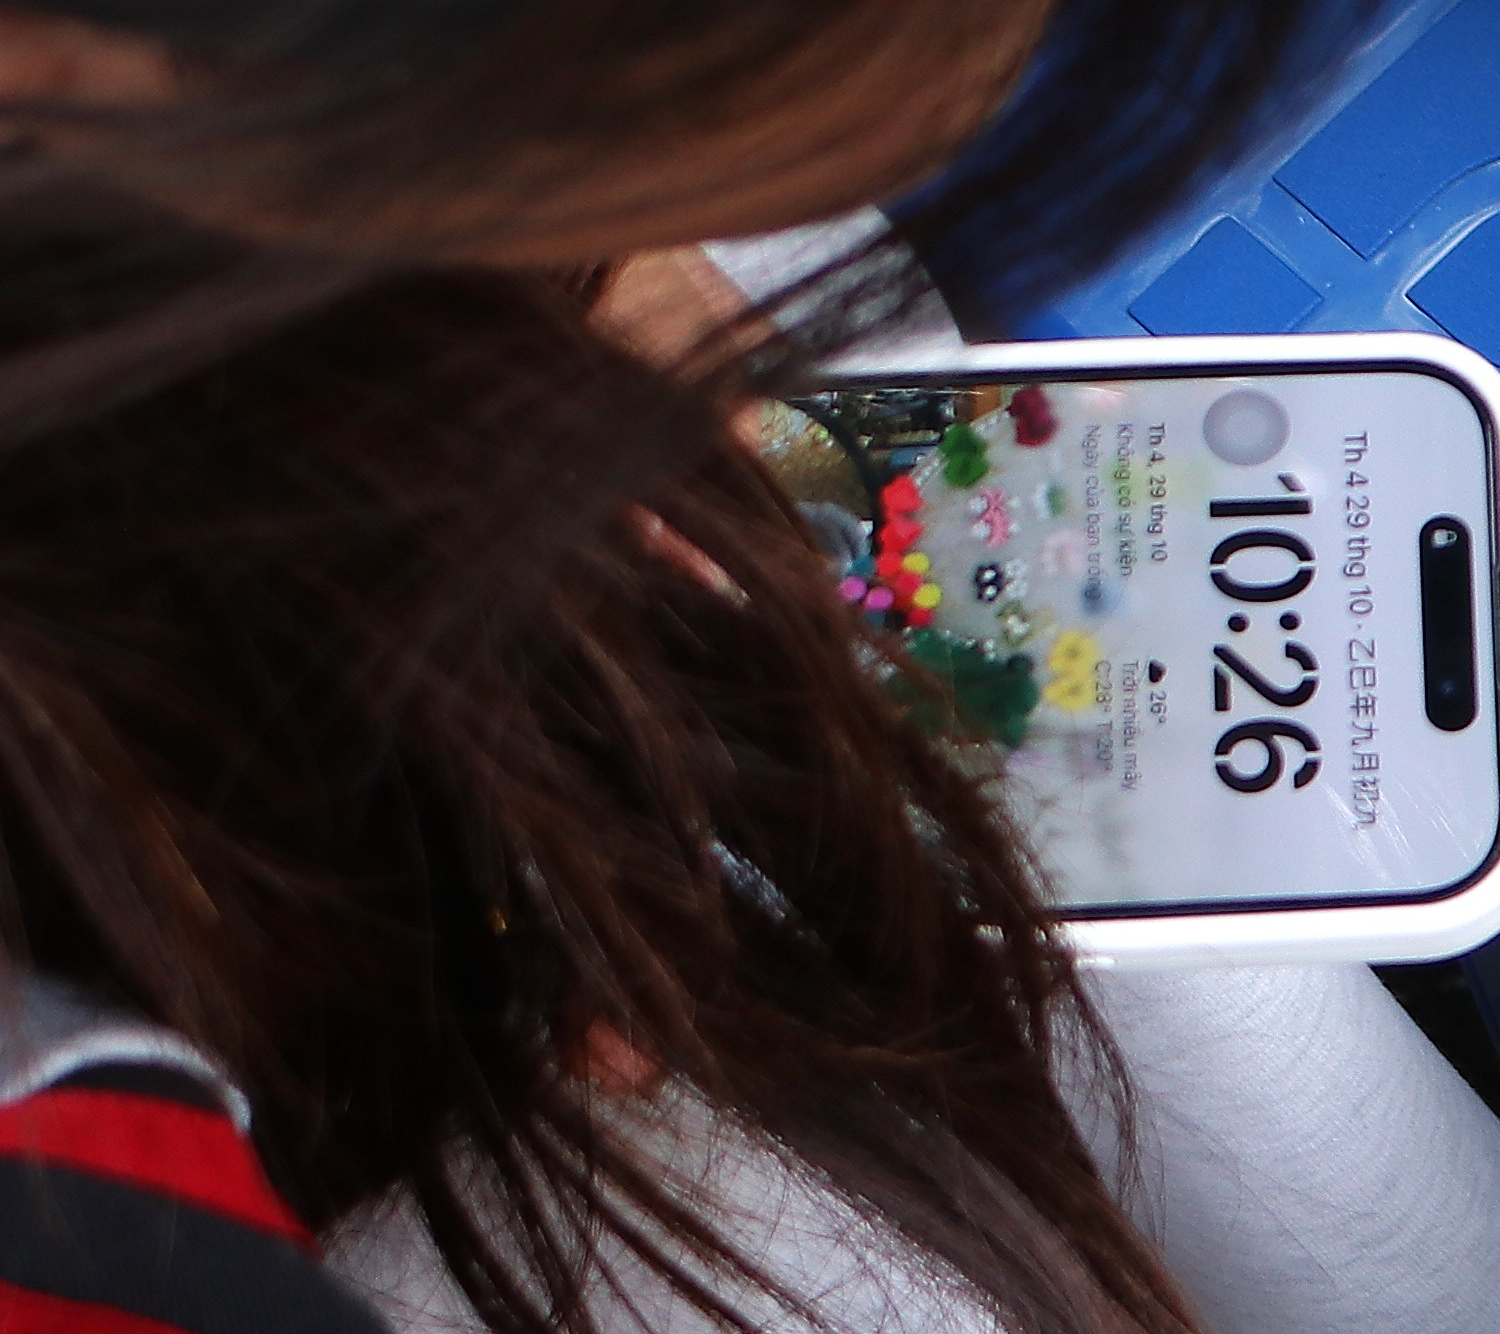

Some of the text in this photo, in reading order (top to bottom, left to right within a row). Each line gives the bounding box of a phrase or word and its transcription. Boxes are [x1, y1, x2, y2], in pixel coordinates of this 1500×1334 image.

[1150, 423, 1166, 445] Th
[1114, 423, 1135, 480] Không
[1150, 475, 1166, 498] 29
[1147, 504, 1168, 535] thg
[1343, 432, 1374, 616] Th 4 29 thg 10
[1151, 541, 1168, 562] 10
[1210, 471, 1323, 794] 10:26
[1150, 690, 1167, 724] 26°
